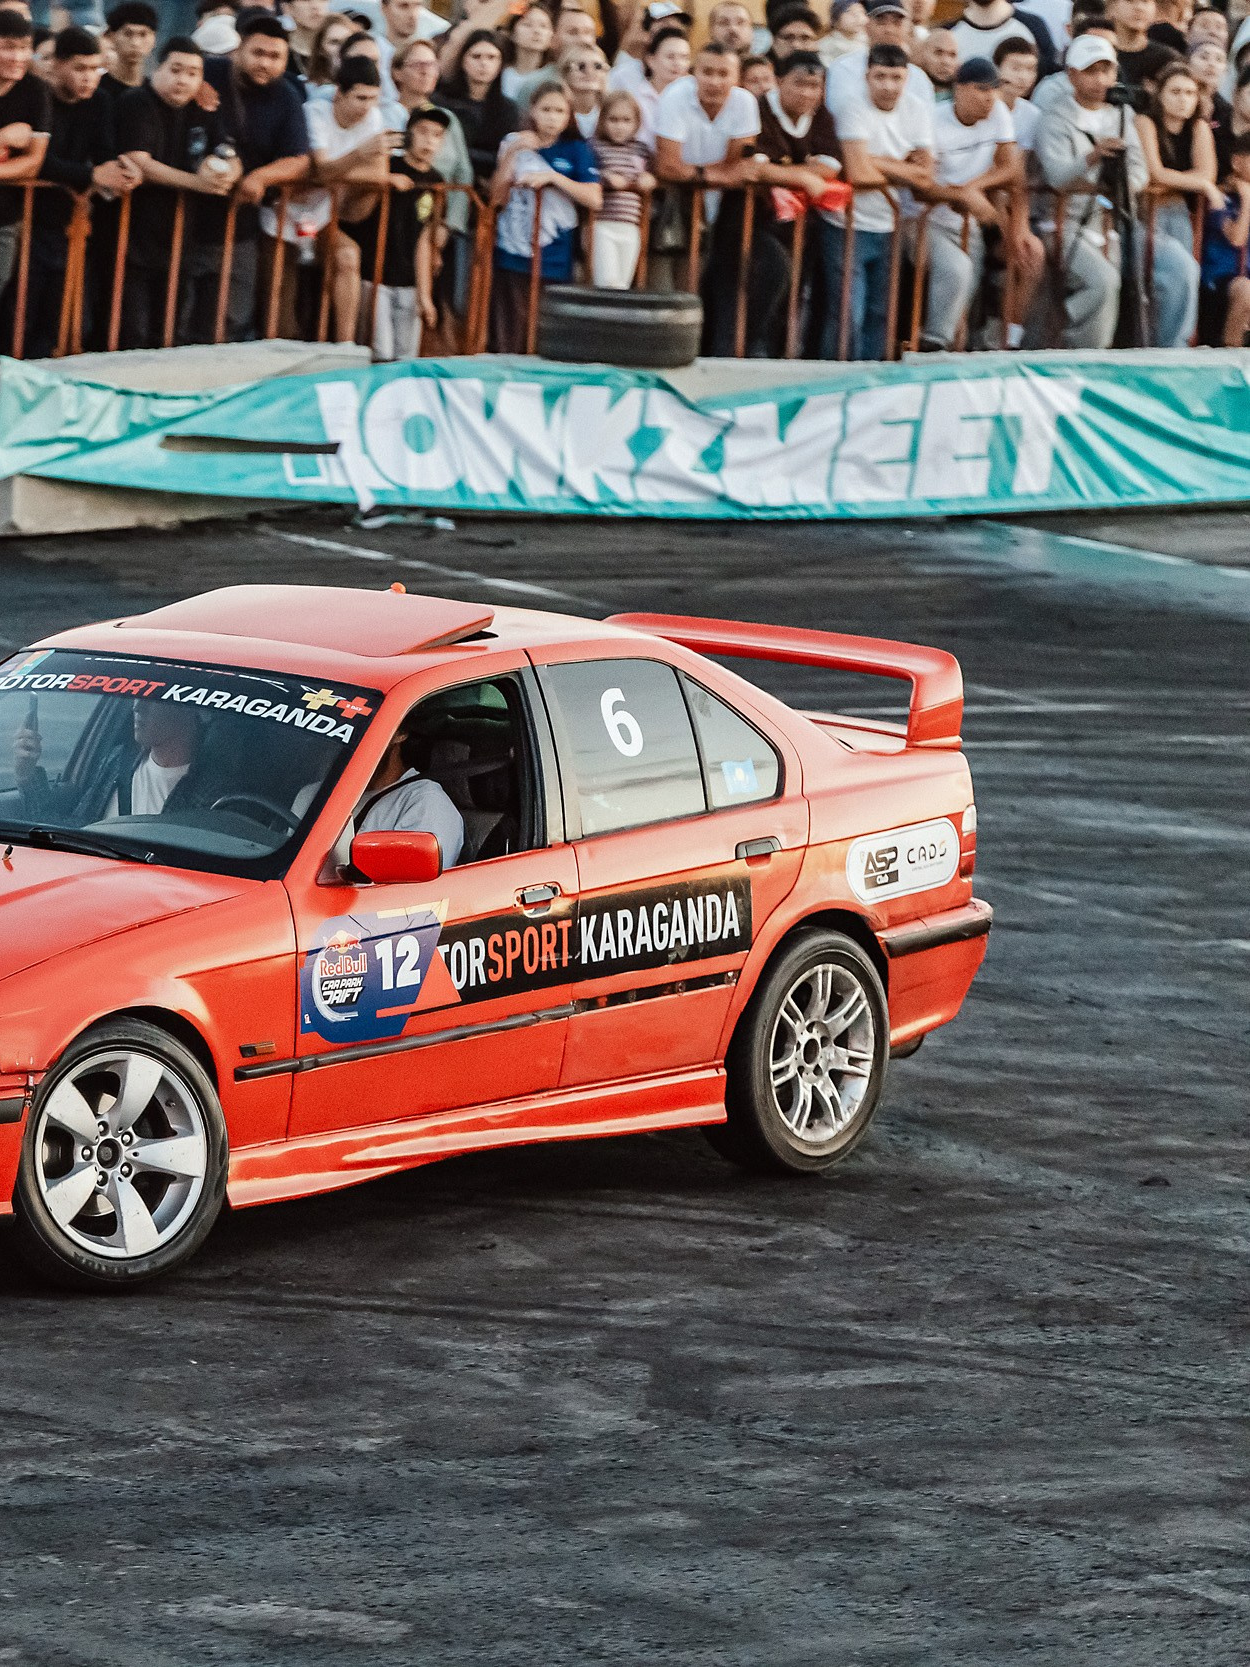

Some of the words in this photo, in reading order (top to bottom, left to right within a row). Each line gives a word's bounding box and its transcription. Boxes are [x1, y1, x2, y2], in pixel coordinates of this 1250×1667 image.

[161, 684, 355, 743] KARAGANDA
[600, 687, 644, 757] 6
[864, 846, 898, 875] ASP
[580, 890, 741, 964] KARAGANDA
[320, 955, 343, 977] Red
[343, 952, 368, 975] Bull
[375, 935, 421, 991] 12
[322, 987, 363, 1005] DRIFT
